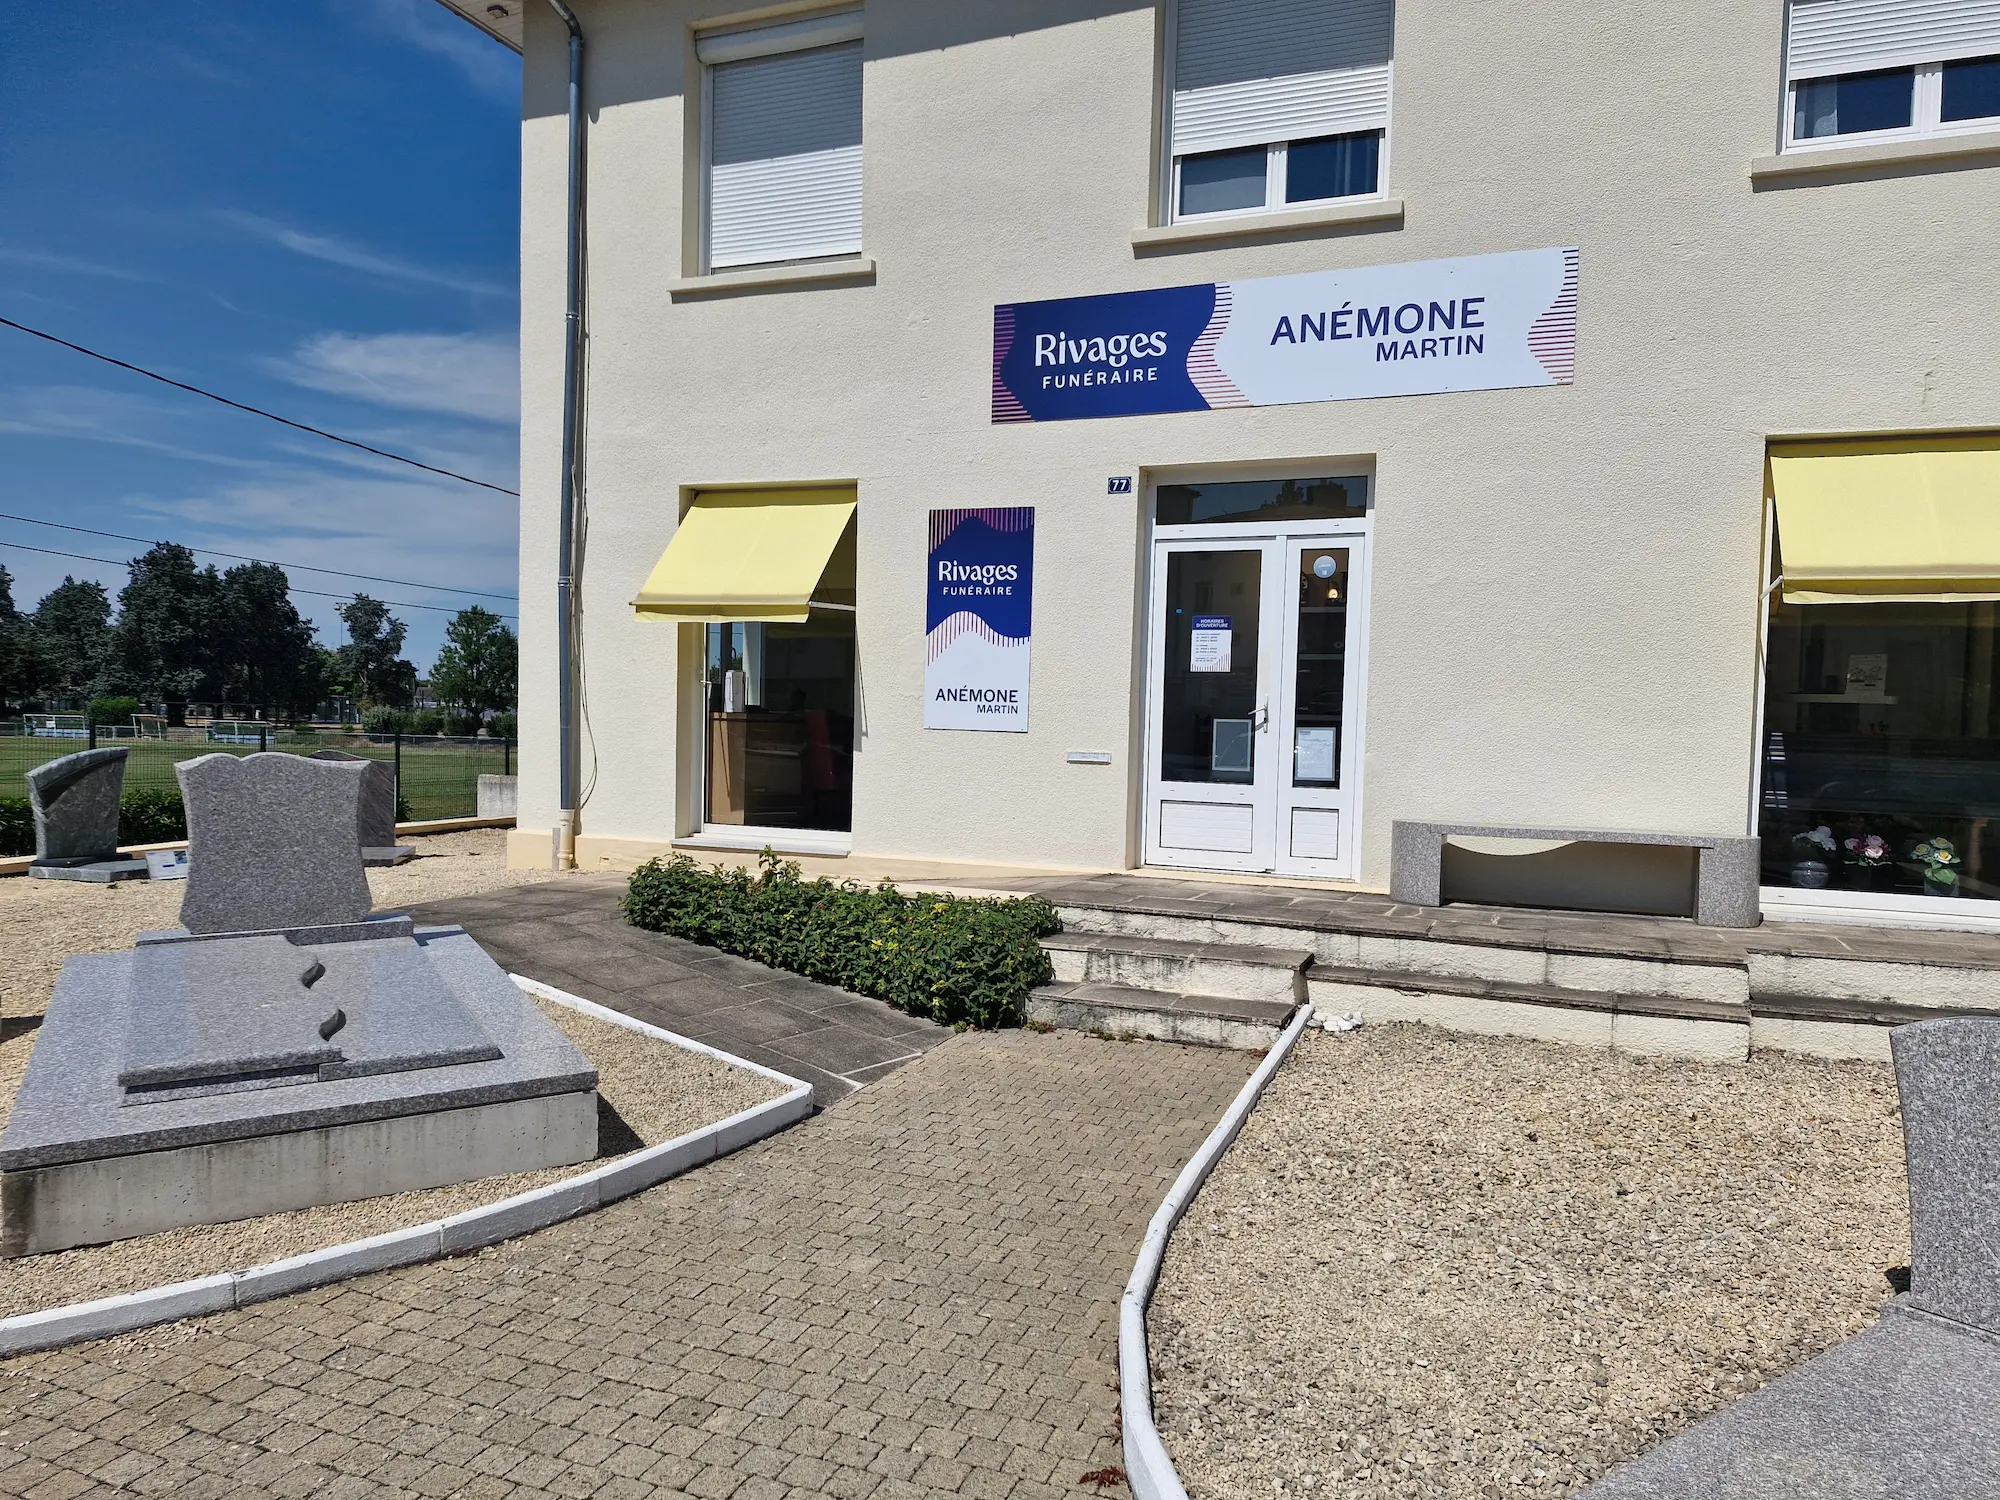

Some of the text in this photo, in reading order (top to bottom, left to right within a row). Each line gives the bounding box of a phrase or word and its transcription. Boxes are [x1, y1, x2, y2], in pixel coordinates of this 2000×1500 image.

[1270, 297, 1485, 346] ANÉMONE
[1034, 330, 1168, 367] Rivages
[1376, 334, 1484, 362] MARTIN
[1042, 367, 1158, 389] FUNÉRAIRE
[1111, 480, 1128, 491] 77
[938, 560, 1018, 585] Rivages
[943, 585, 1013, 596] FUNÉRAIRE
[935, 685, 1019, 703] ANÉMONE
[976, 704, 1019, 714] MARTIN
